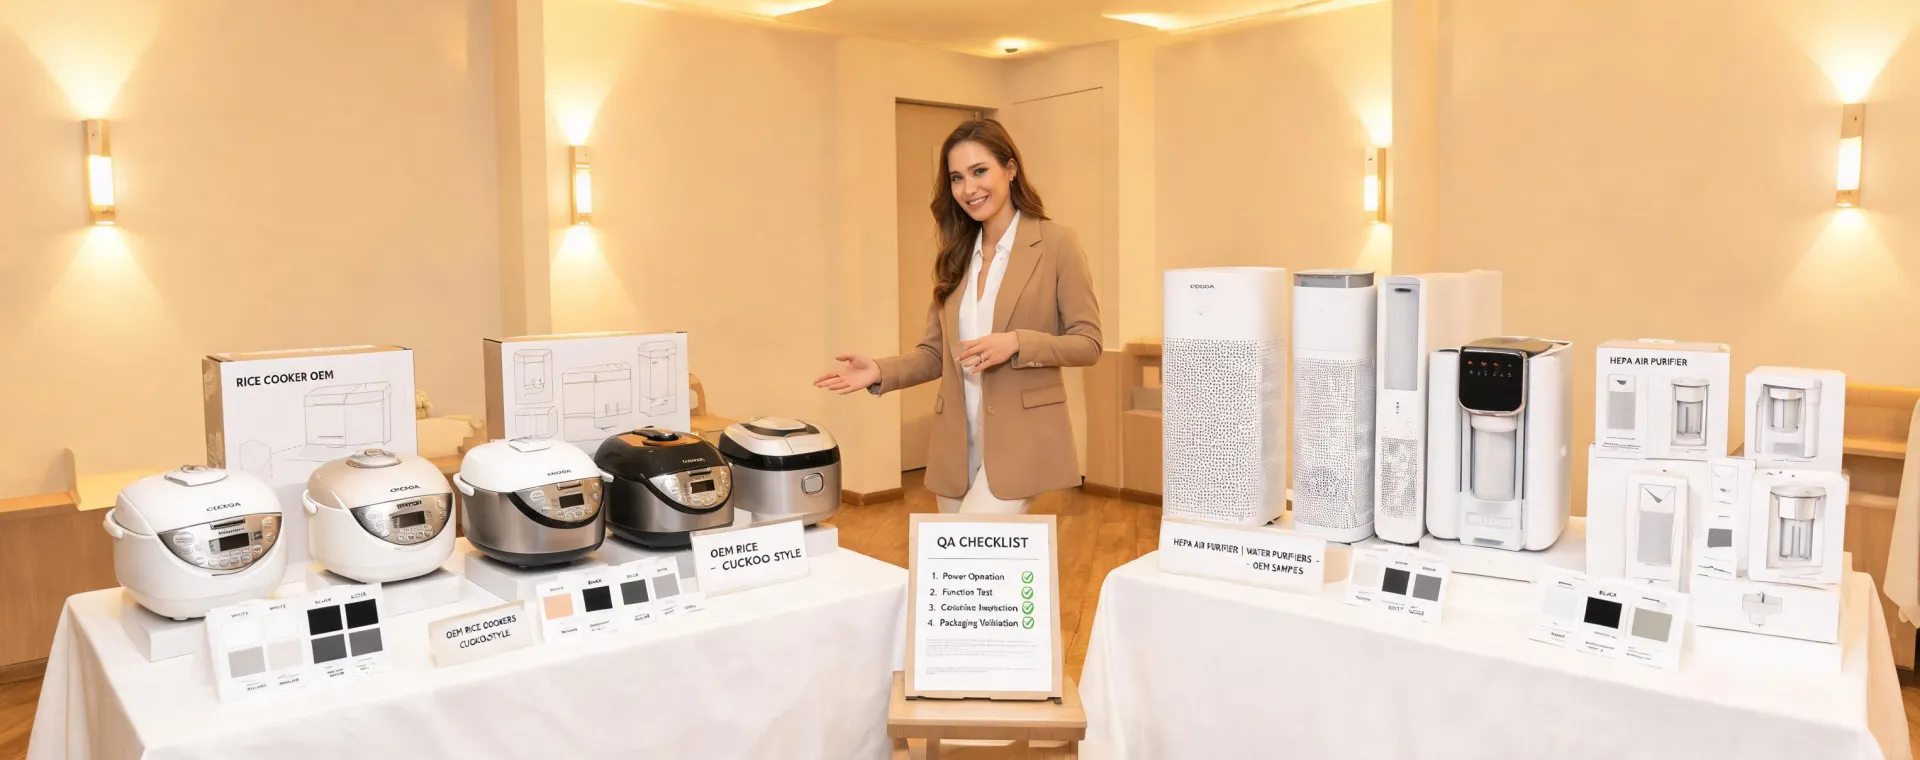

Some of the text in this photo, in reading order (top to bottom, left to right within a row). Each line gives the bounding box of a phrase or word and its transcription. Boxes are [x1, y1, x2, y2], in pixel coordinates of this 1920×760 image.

[1610, 357, 1688, 367] HEPA AIR PURIFIER
[236, 370, 334, 388] RICE COOKER OEM
[937, 536, 1029, 549] QA CHECKLIST
[1173, 538, 1192, 547] HEPA
[1194, 541, 1205, 549] AIR
[1246, 547, 1271, 557] WATER
[710, 542, 758, 558] OEM RICE
[722, 554, 770, 570] CUCKOO
[774, 549, 801, 561] STYLE
[1252, 561, 1270, 571] OEM
[943, 572, 966, 580] Power
[930, 588, 993, 596] 2. Function Test
[928, 604, 936, 612] 3.
[940, 619, 978, 629] Packaging
[446, 627, 464, 639] OEM
[465, 623, 481, 634] RICE
